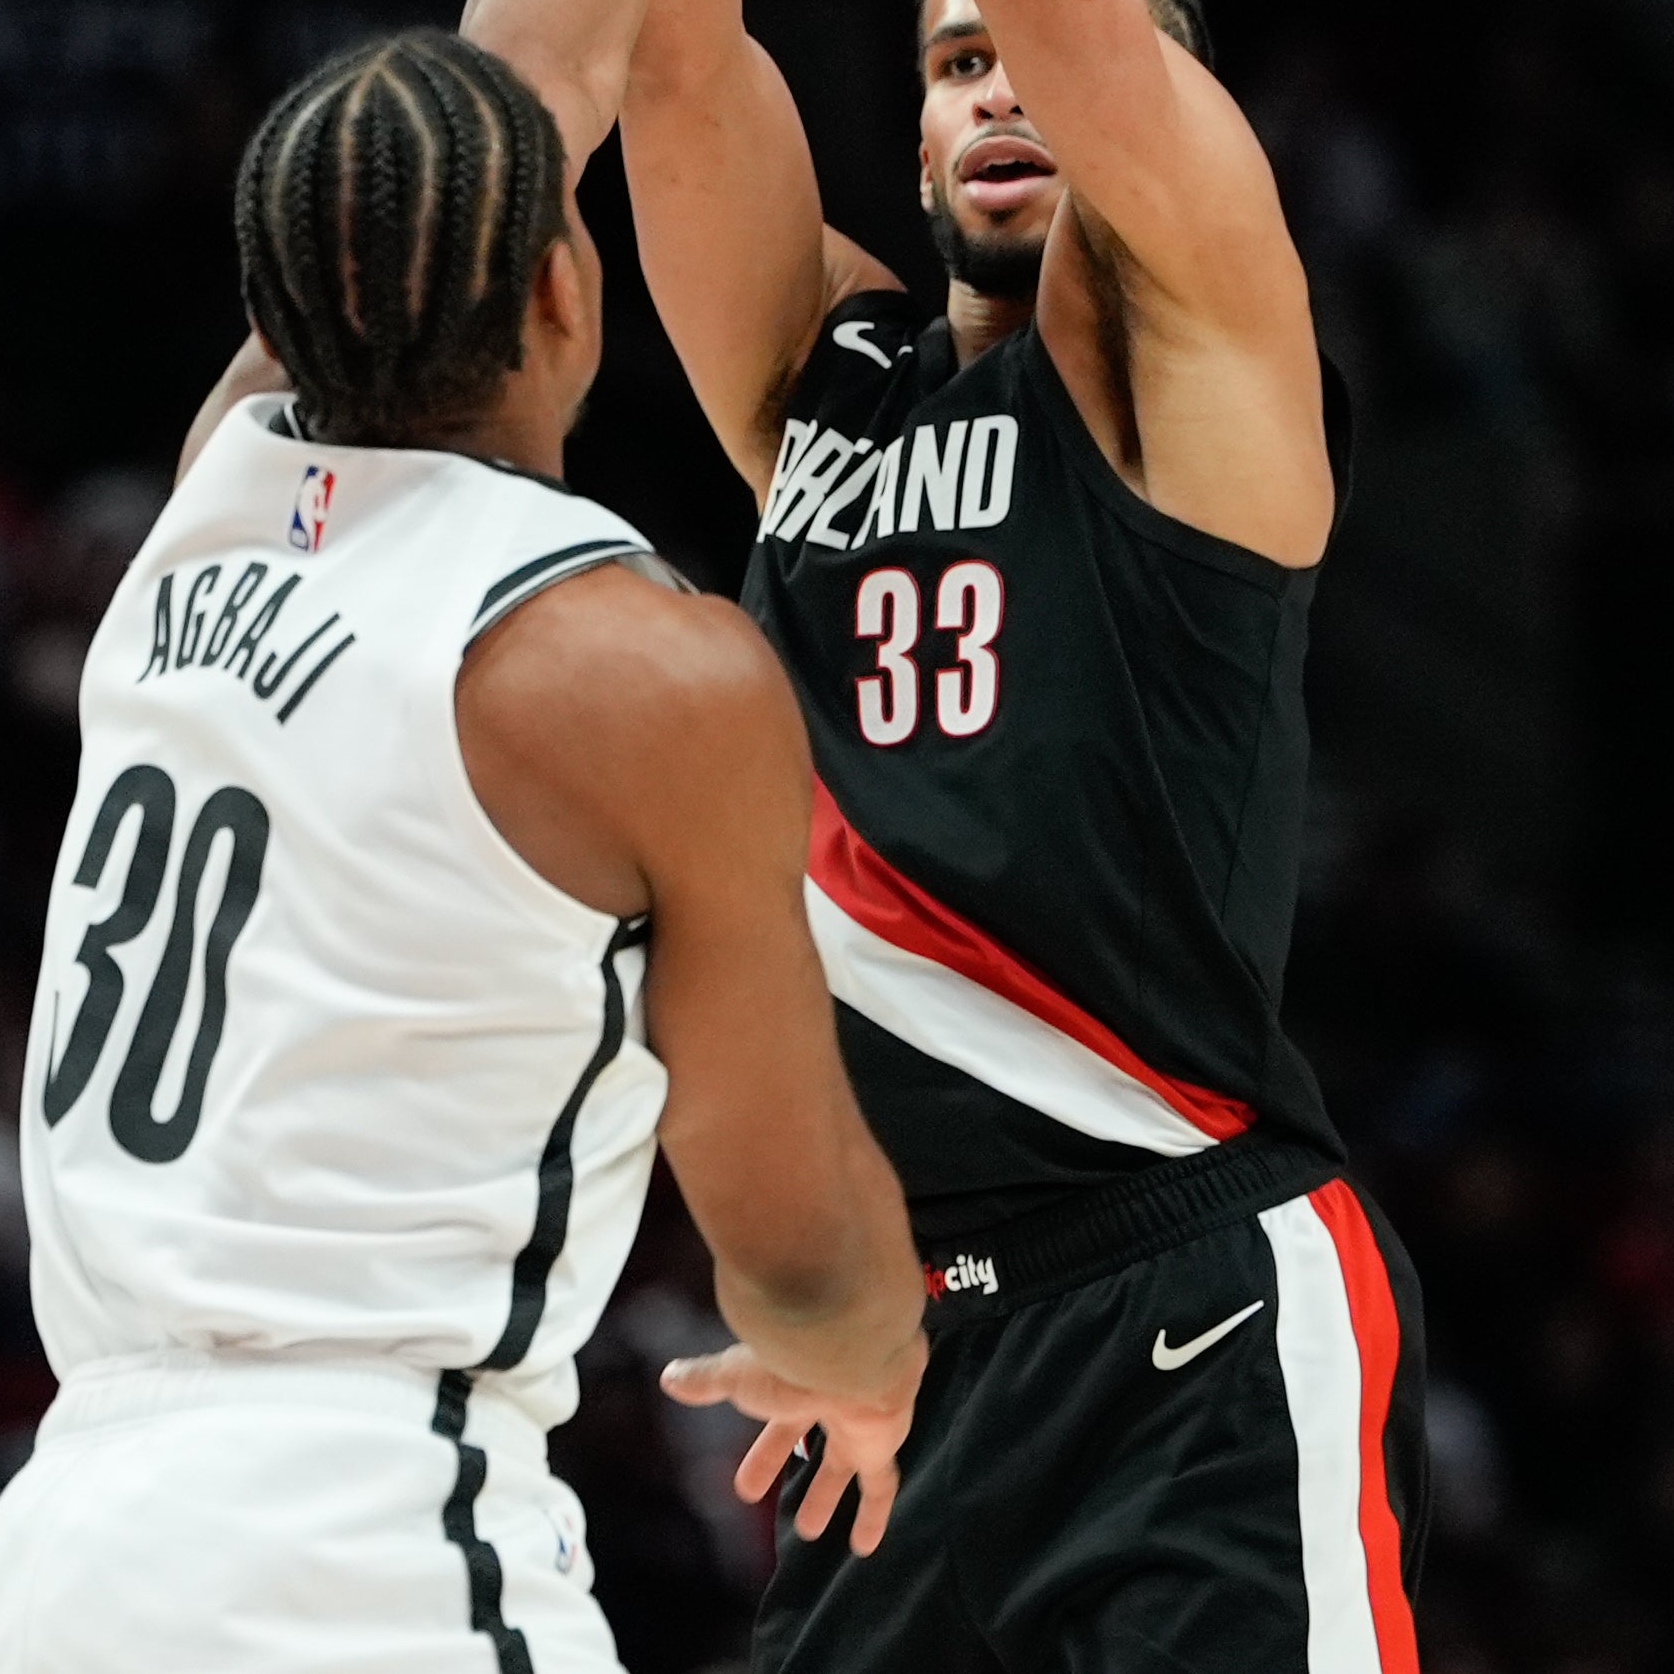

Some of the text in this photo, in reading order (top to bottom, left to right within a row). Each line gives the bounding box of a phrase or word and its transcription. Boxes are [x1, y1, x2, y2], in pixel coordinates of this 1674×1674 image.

[135, 561, 357, 726] AGBAJI
[854, 558, 1006, 748] 33
[43, 764, 271, 1164] 30
